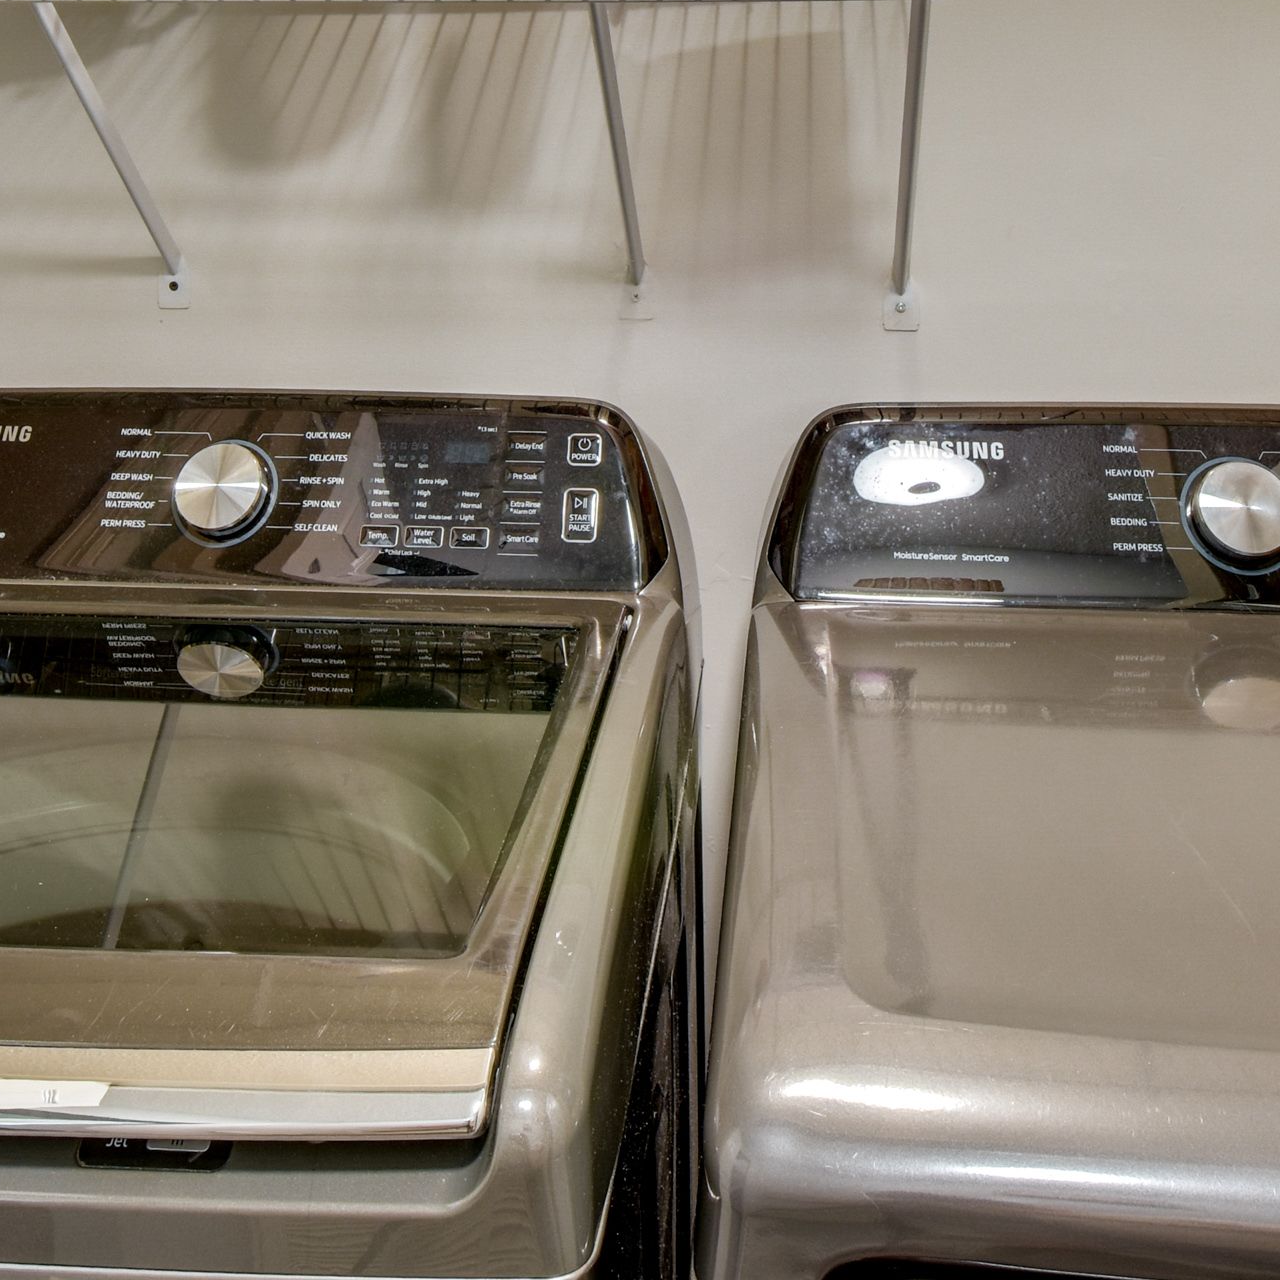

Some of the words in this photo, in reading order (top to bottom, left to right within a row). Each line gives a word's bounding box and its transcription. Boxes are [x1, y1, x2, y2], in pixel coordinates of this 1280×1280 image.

[120, 428, 153, 436] NORMAL
[305, 431, 328, 439] QUICK
[329, 432, 351, 440] WASH
[515, 443, 531, 451] Delay
[888, 440, 1005, 460] SAMSUNG
[1103, 445, 1138, 453] NORMAL
[115, 450, 141, 458] HEAVY
[141, 451, 161, 459] DUTY
[309, 454, 348, 462] DELICATES
[571, 453, 597, 461] POWER
[110, 473, 130, 481] DEEP
[131, 473, 154, 481] WASH
[1105, 469, 1132, 477] HEAVY
[299, 476, 322, 484] RINSE
[326, 477, 345, 485] SPIN
[434, 478, 448, 486] High
[106, 491, 144, 500] BEDDING/
[1107, 493, 1144, 502] SANITIZE
[105, 500, 156, 509] WATERPROOF
[302, 500, 320, 508] SPIN
[321, 500, 342, 508] ONLY
[100, 519, 121, 527] PERM
[122, 520, 146, 528] PRESS
[1110, 518, 1148, 527] BEDDING
[294, 523, 313, 531] SELF
[313, 524, 338, 532] CLEAN
[569, 524, 591, 532] PAUSE
[368, 531, 389, 540] Temp.
[413, 529, 435, 537] Water
[462, 533, 476, 541] Soil
[1113, 543, 1136, 551] PERM
[1137, 544, 1163, 552] PRESS
